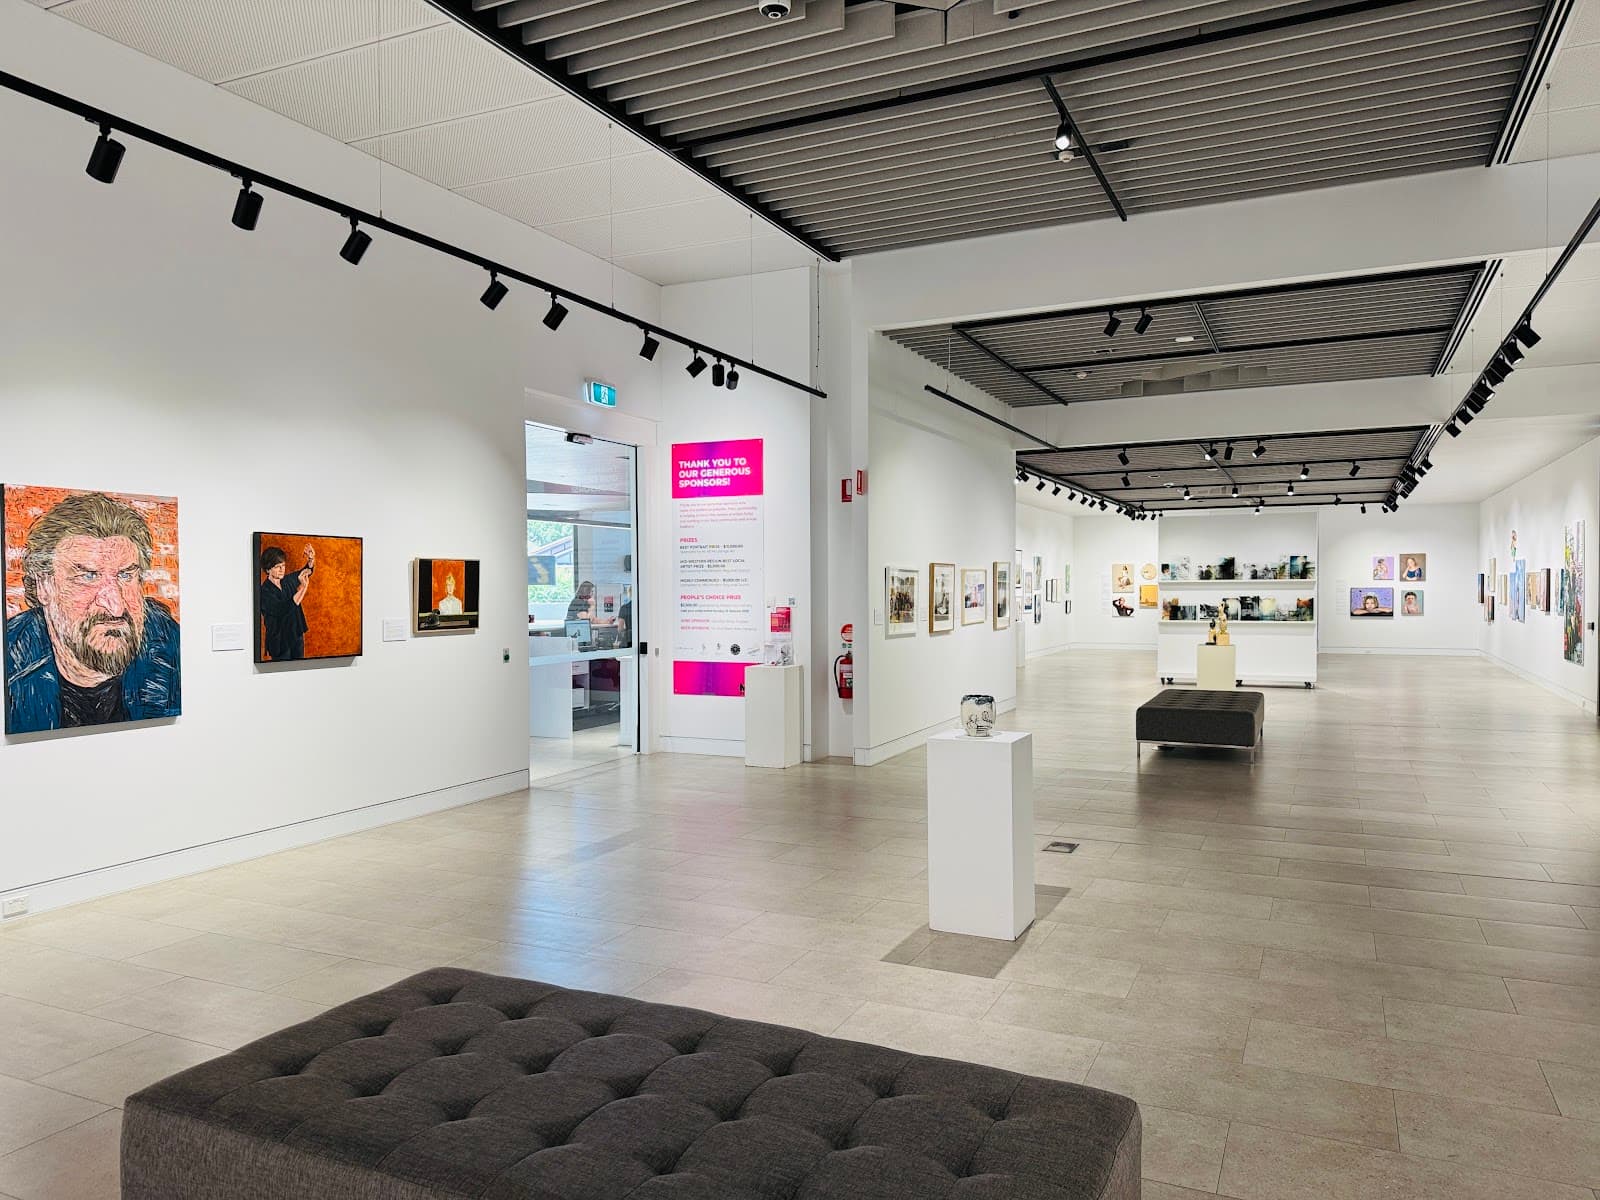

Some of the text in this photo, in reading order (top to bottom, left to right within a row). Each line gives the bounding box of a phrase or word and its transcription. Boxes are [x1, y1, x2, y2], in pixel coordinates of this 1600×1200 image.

[679, 460, 710, 468] THANK
[700, 467, 750, 477] GENEROUS
[679, 478, 730, 487] SPONSORS!
